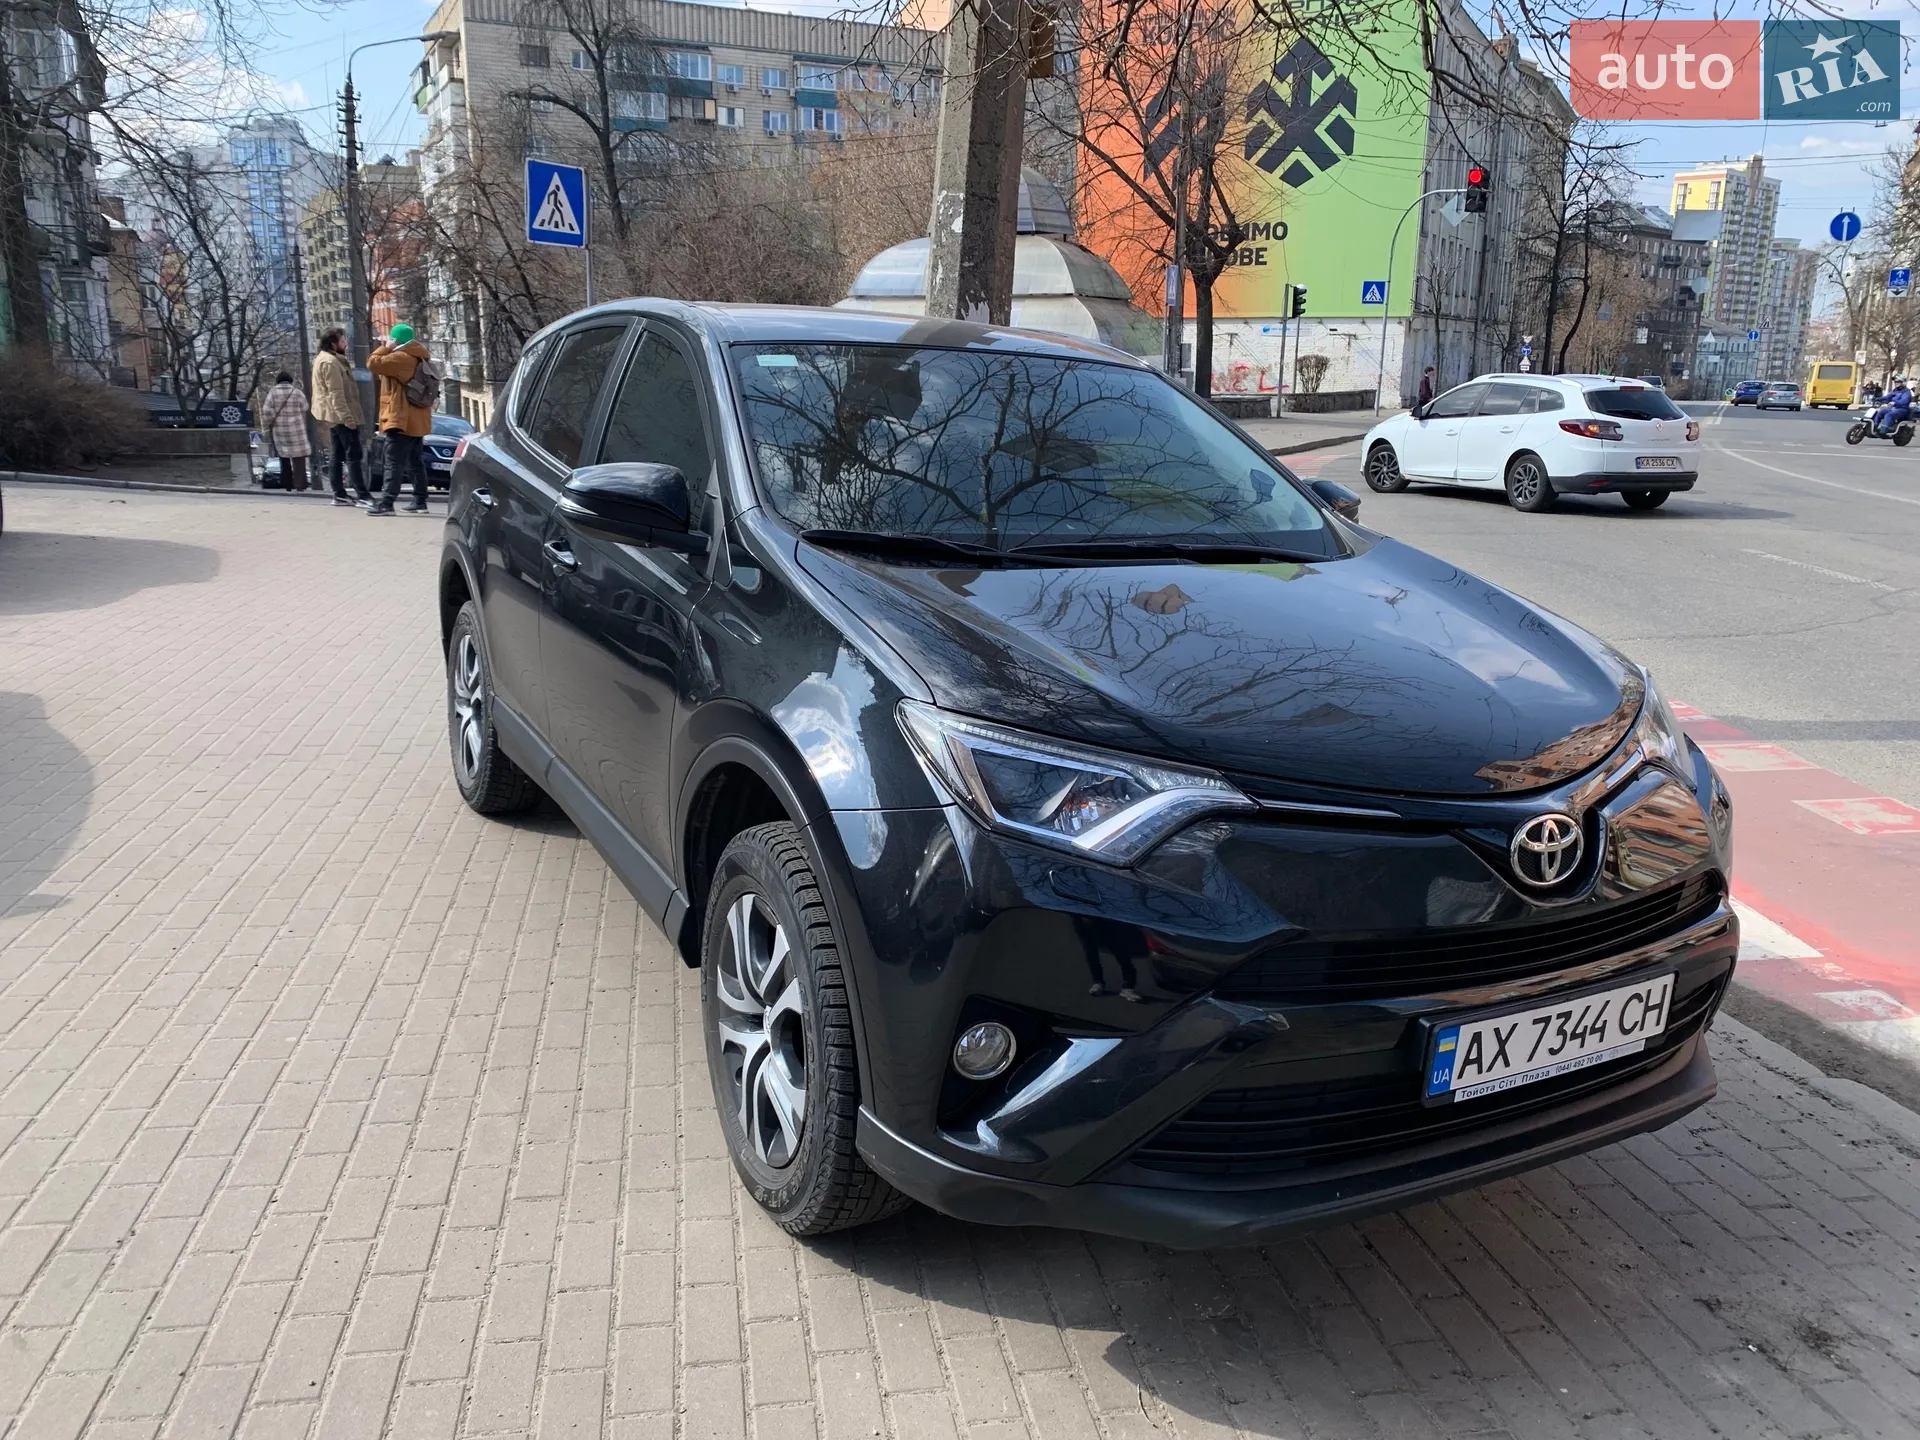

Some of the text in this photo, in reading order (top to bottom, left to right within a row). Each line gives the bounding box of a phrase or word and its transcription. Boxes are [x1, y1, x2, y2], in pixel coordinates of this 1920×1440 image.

[1457, 984, 1669, 1080] AX 7344 CH
[1432, 1067, 1451, 1085] UA
[1461, 1083, 1496, 1099] Тойота
[1498, 1076, 1518, 1090] Сіті
[1521, 1069, 1551, 1084] Плаза
[1555, 1061, 1573, 1075] (044)
[1573, 1058, 1585, 1069] 492
